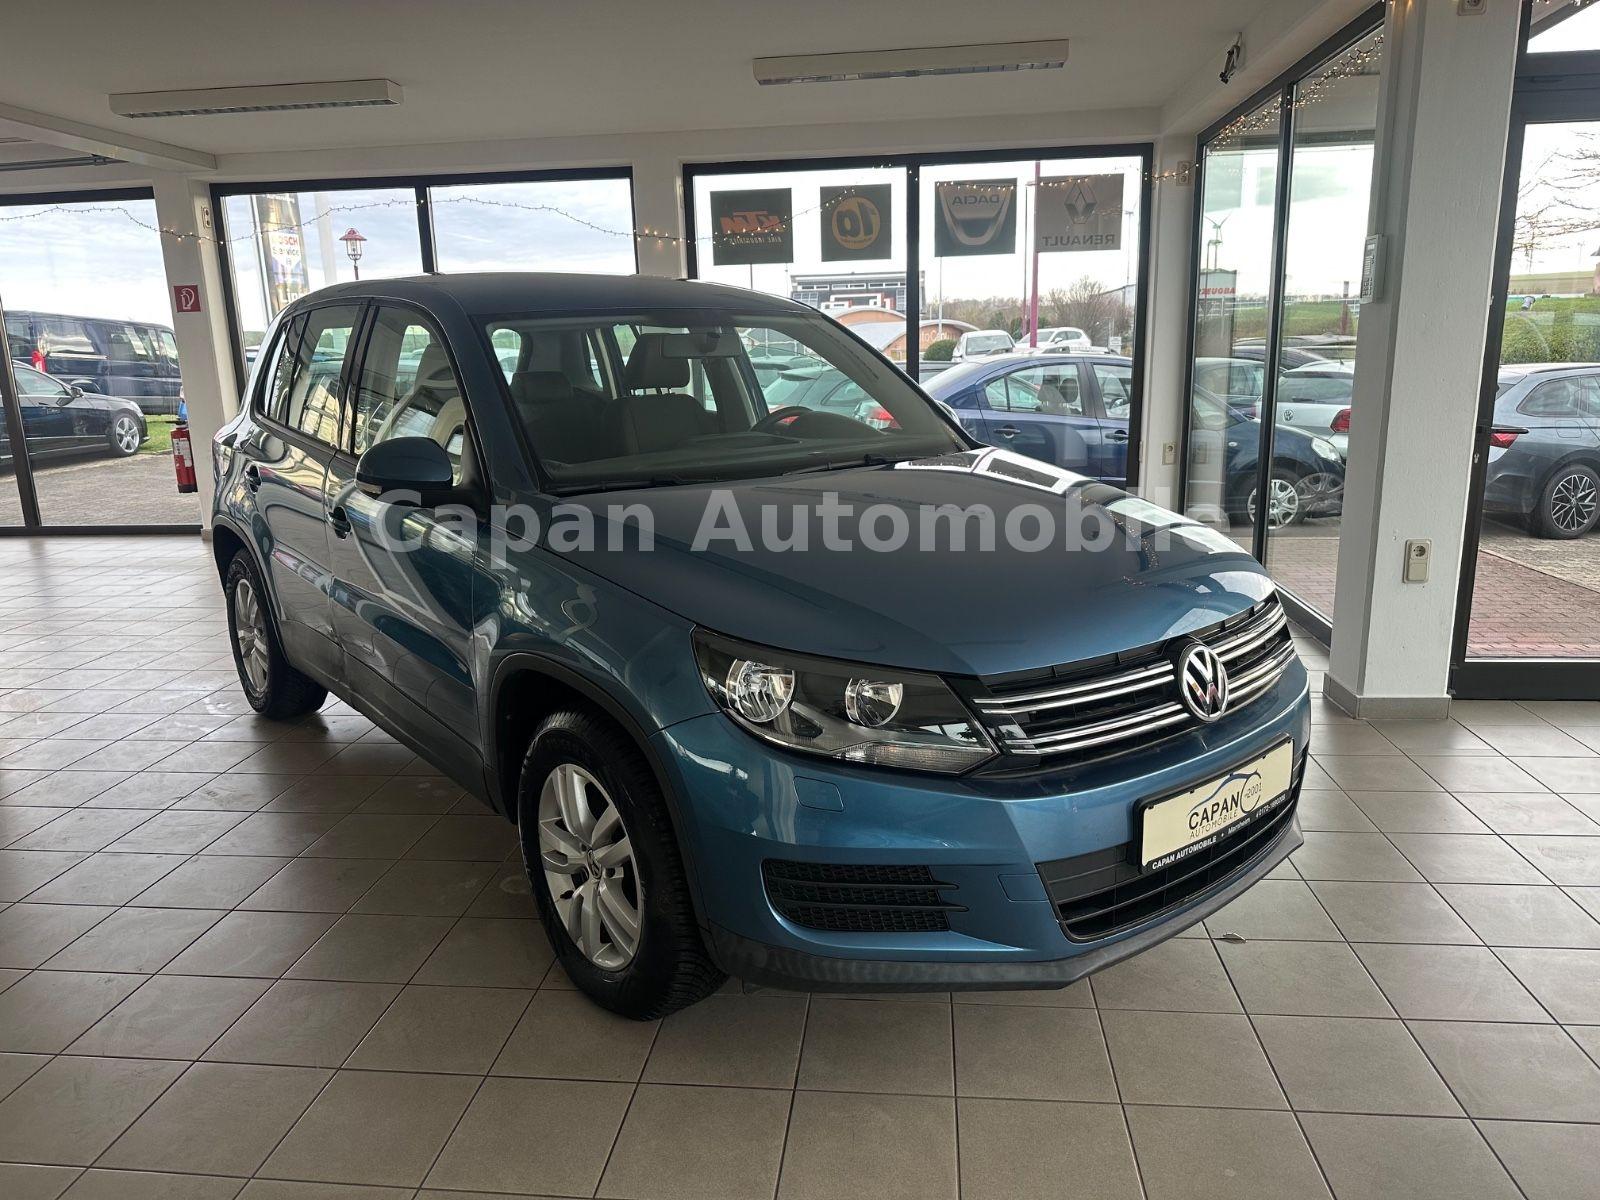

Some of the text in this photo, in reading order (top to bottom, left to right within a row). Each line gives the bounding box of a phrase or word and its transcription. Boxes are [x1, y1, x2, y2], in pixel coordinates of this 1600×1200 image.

[1189, 791, 1240, 830] CAPAN
[1189, 809, 1238, 839] AUTOMOBILE
[1152, 855, 1175, 870] CAPAN
[1176, 836, 1217, 861] AUTOMOBILE
